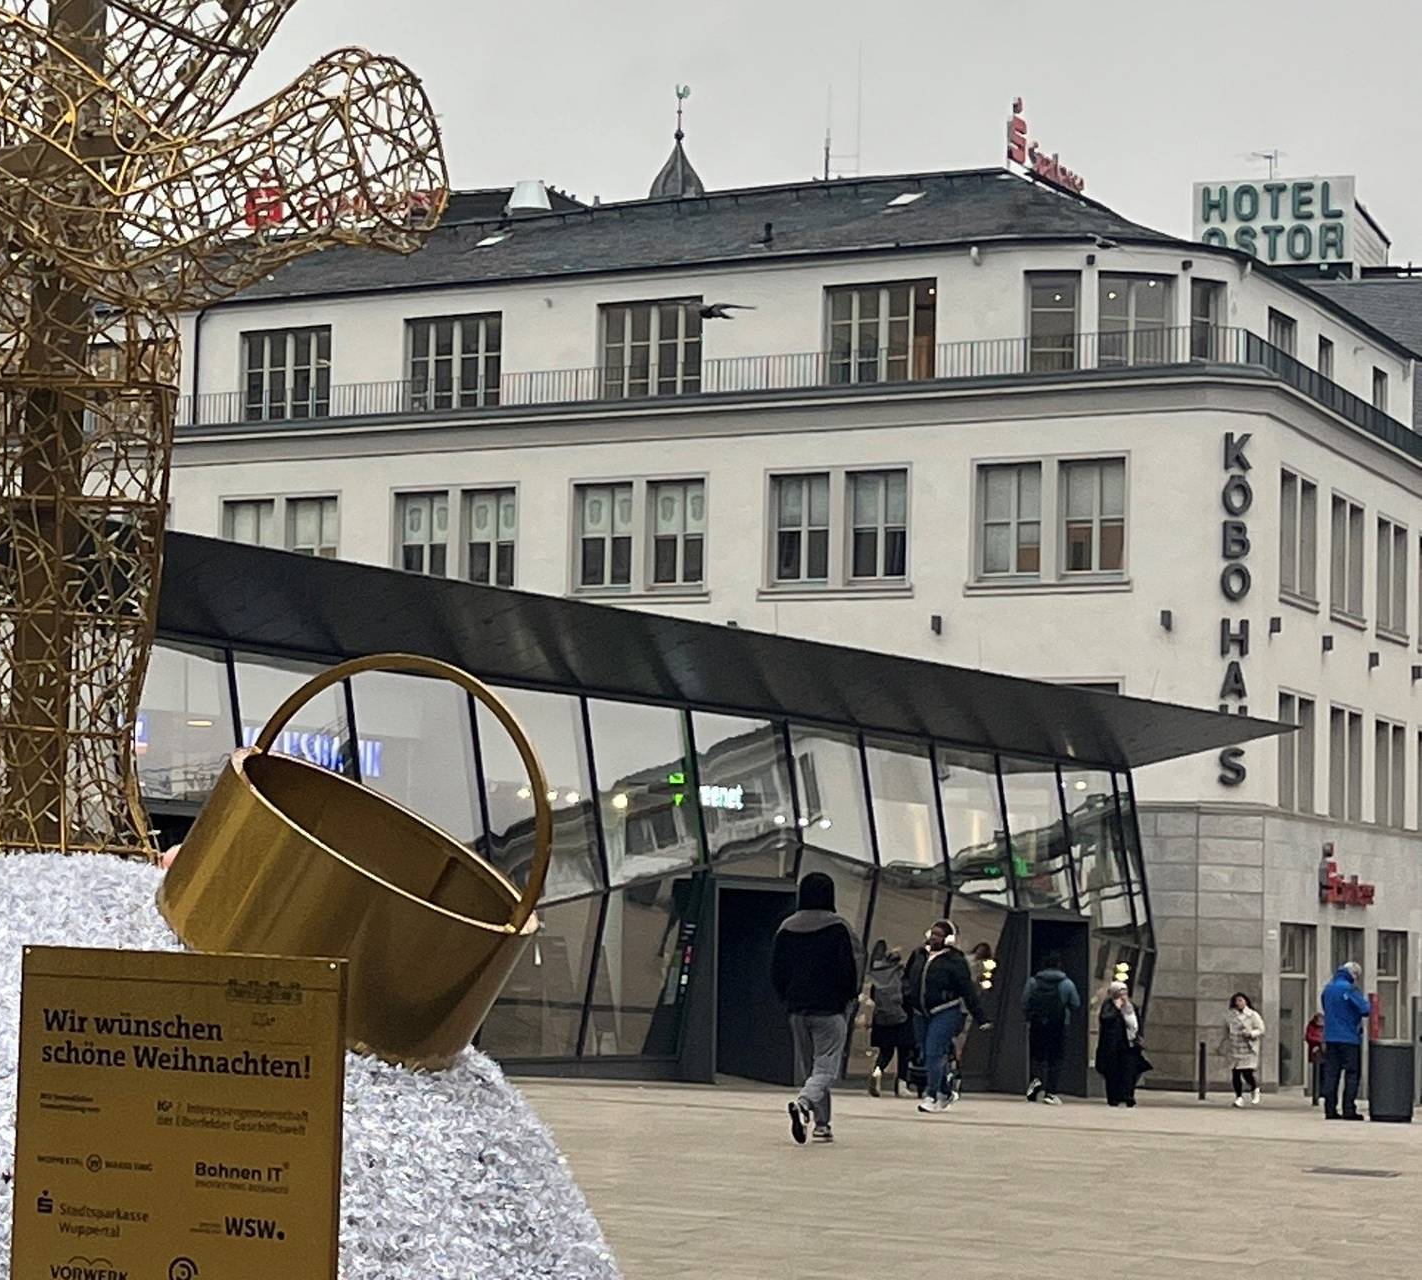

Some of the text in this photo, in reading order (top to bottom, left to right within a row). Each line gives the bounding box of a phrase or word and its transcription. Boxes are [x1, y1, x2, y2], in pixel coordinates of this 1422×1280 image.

[1202, 181, 1344, 223] HOTEL
[42, 1008, 224, 1042] Wir wünschen
[41, 1040, 312, 1080] schöne Weihnachten!
[195, 1161, 263, 1181] Bohnen
[58, 1202, 150, 1223] Stadtsparkasse
[58, 1221, 122, 1238] Wuppertal
